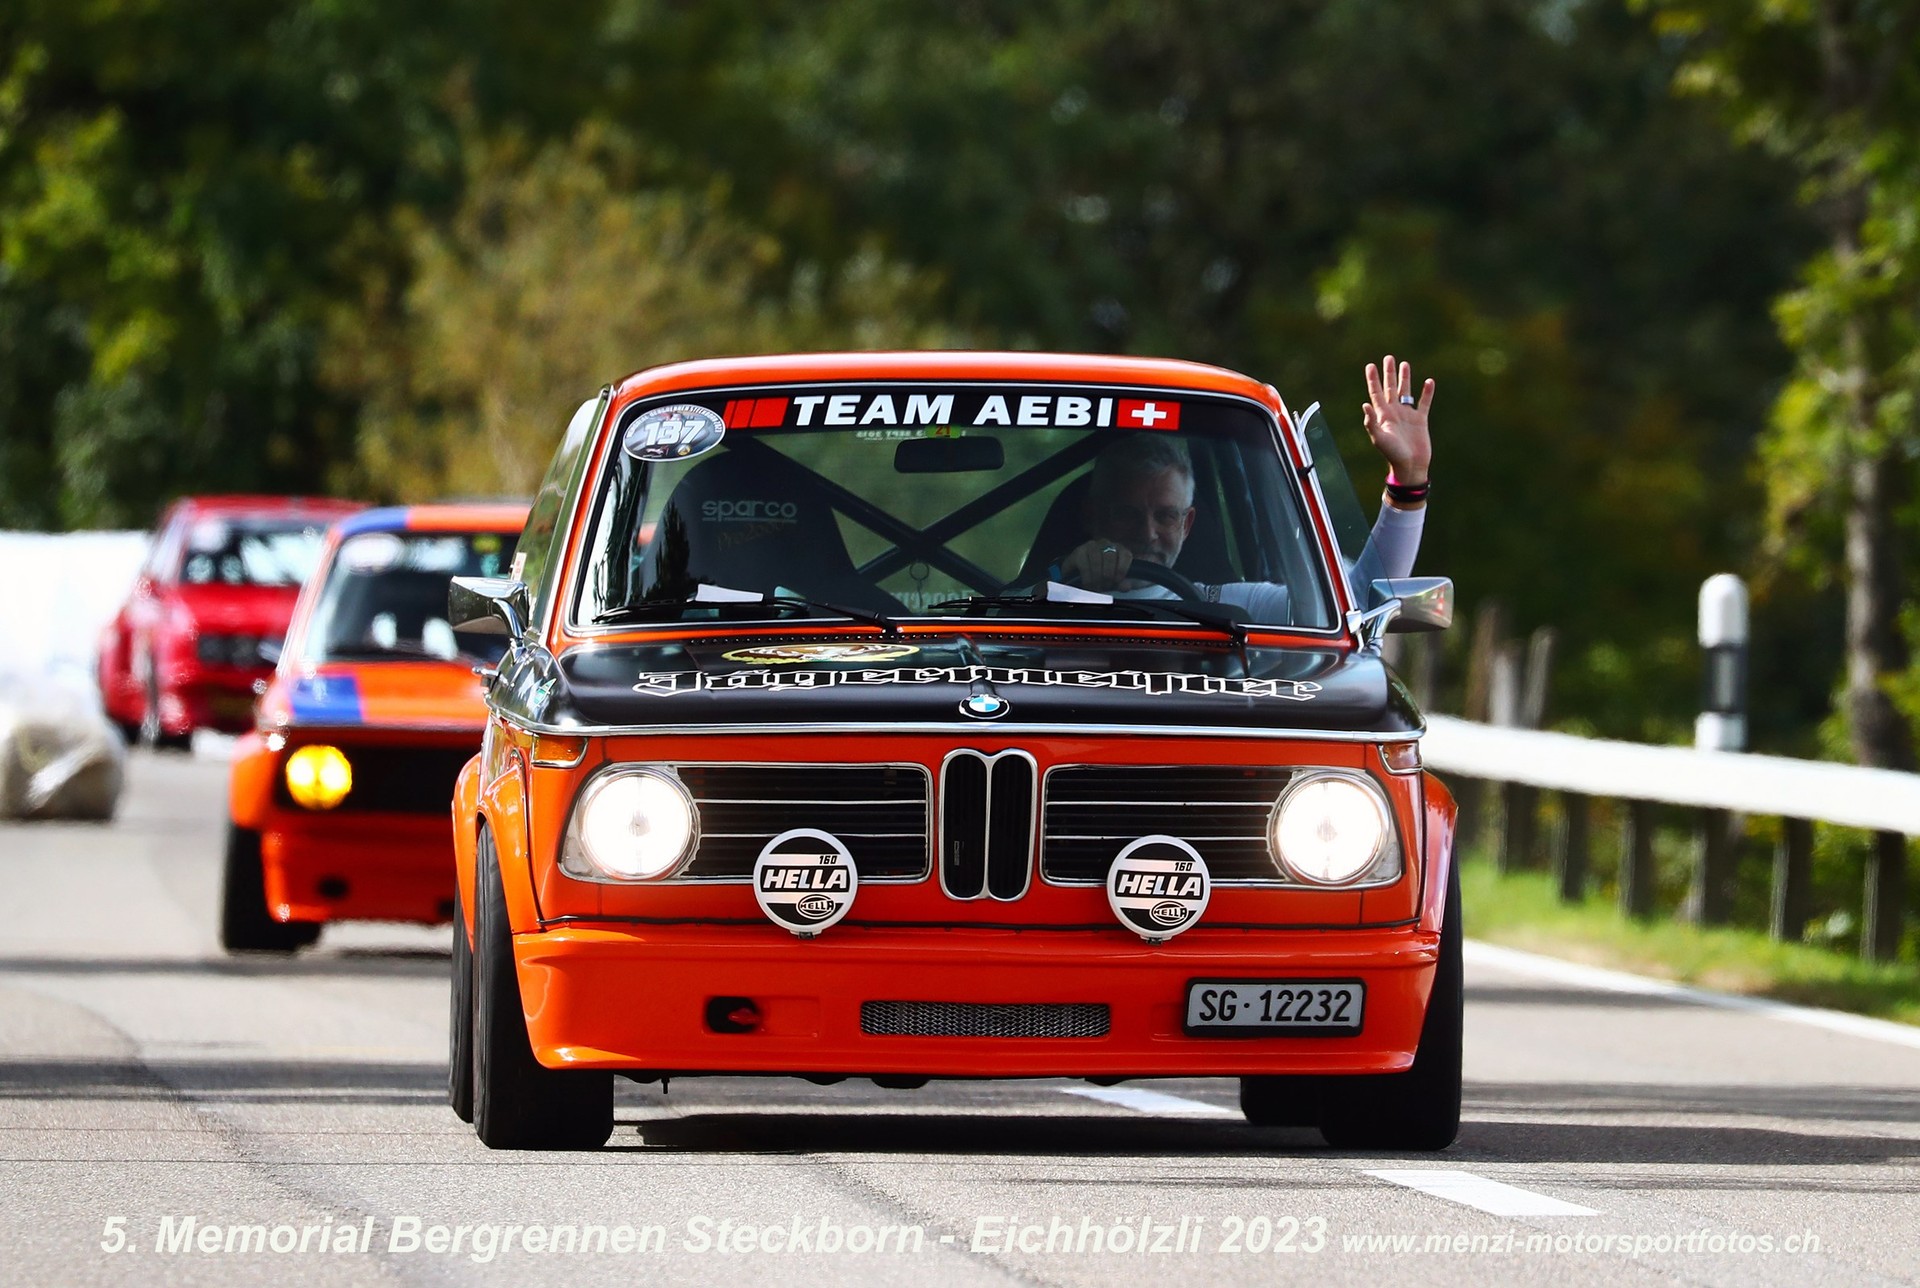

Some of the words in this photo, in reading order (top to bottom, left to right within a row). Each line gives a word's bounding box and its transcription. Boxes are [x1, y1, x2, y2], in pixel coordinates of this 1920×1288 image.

[793, 394, 954, 425] TEAM
[972, 394, 1113, 427] AEBI
[644, 420, 706, 446] 137
[702, 500, 798, 522] sparco
[819, 855, 838, 864] 160
[1174, 862, 1193, 872] 160
[763, 869, 847, 889] HELLA
[1117, 874, 1201, 896] HELLA
[800, 900, 834, 911] HELLA
[1153, 907, 1187, 918] HELLA
